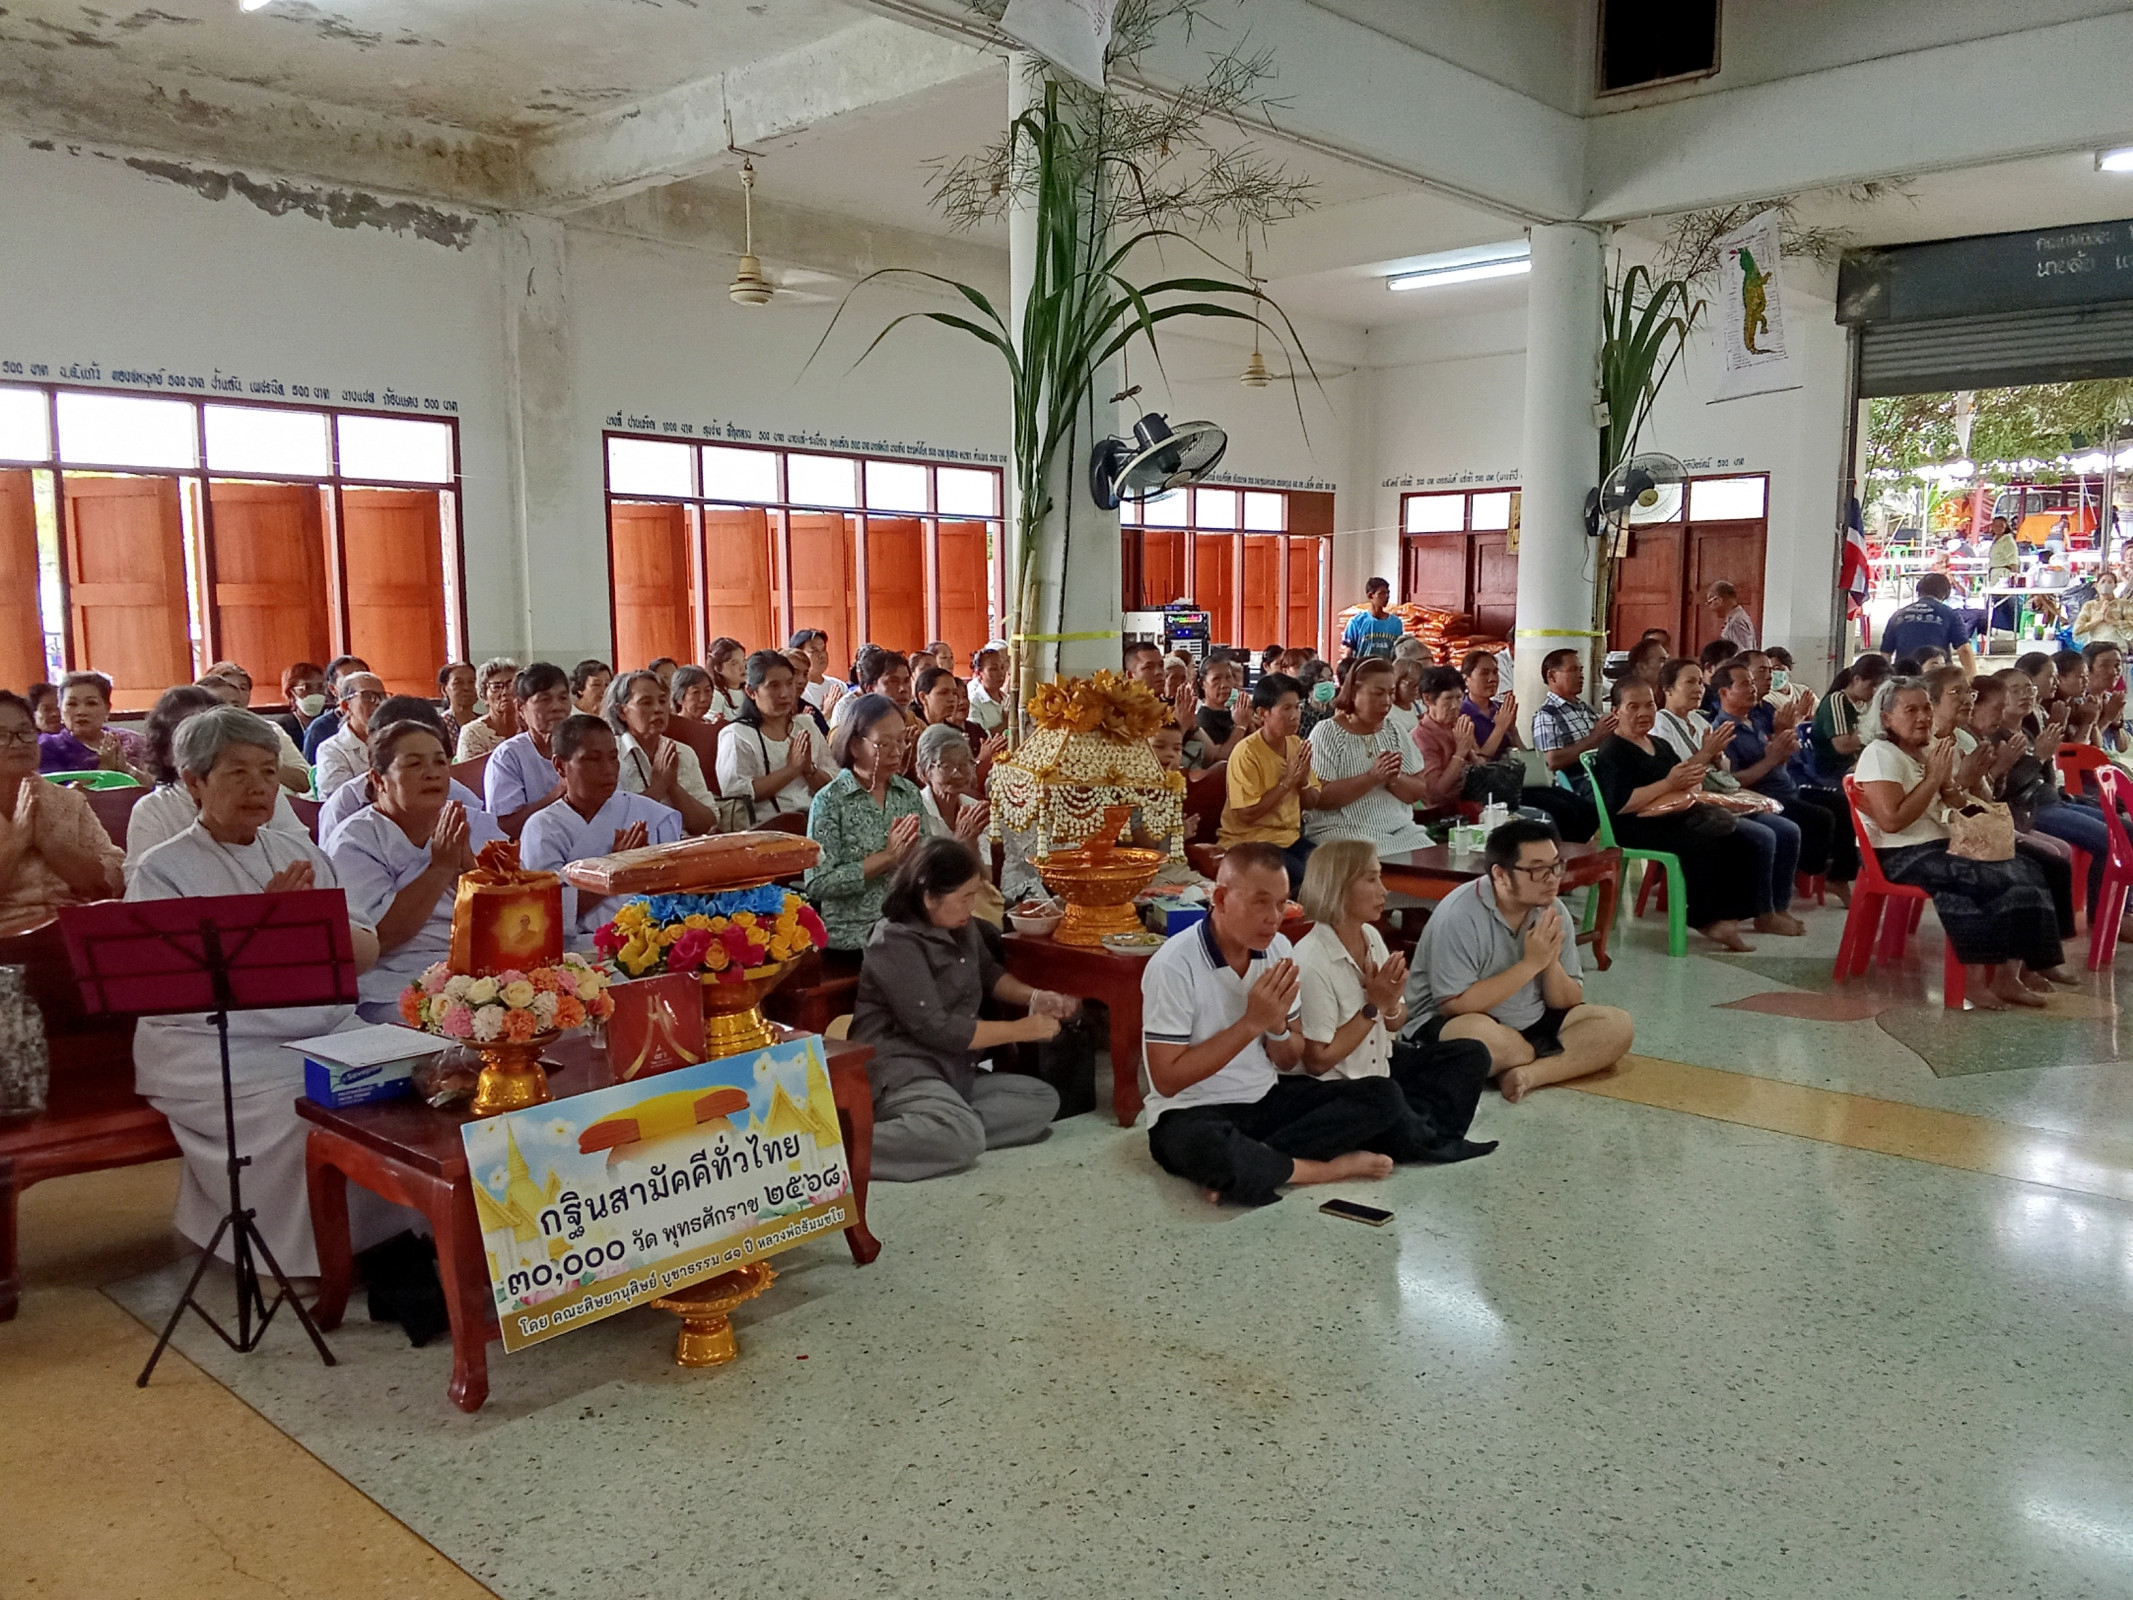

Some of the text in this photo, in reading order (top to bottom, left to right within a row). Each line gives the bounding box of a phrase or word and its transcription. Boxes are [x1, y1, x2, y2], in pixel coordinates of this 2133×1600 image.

[292, 385, 309, 398] 500
[508, 1163, 841, 1296] ๓๐,๐๐๐ วัด พุทธศักราช ๒๕๖๘
[541, 1134, 800, 1240] กฐินสามัคคีทั่วไทย
[519, 1207, 846, 1336] โดย คณะศิษยานุศิษย์ บูชาธรรม ๘๑ ปี หลวงพ่อธัมมชโย
